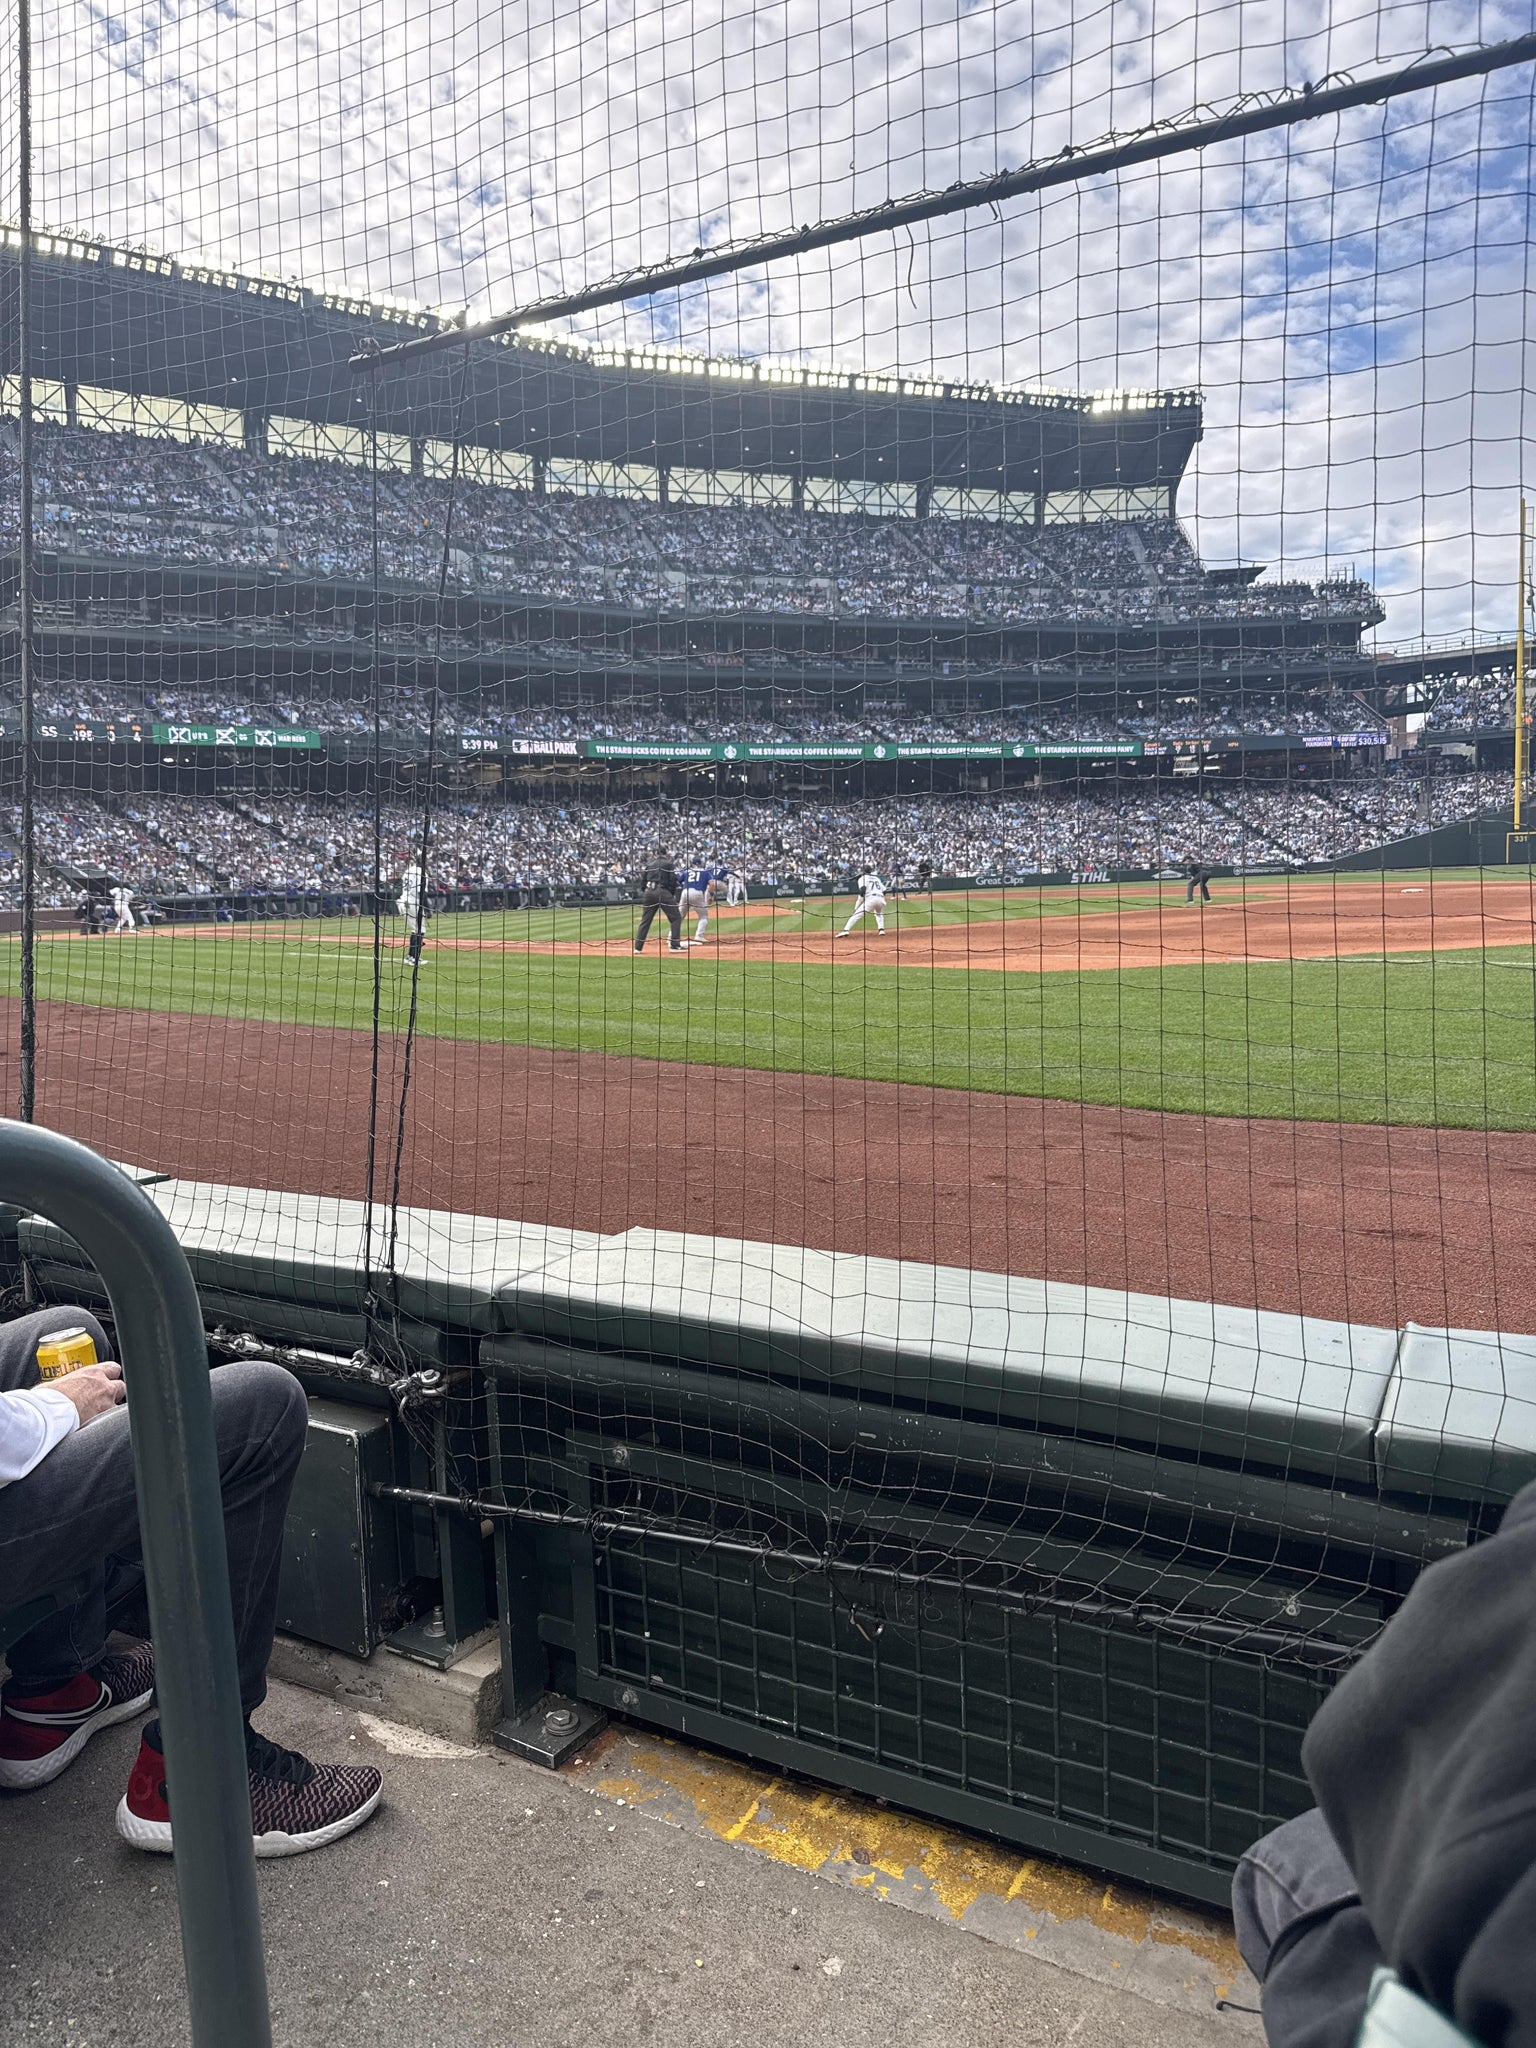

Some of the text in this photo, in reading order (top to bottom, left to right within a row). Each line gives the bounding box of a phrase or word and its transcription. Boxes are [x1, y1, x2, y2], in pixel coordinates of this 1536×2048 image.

[41, 726, 58, 737] SS
[133, 732, 141, 742] 4
[462, 739, 498, 750] 5:39 PM
[534, 741, 577, 754] BALLPARK
[595, 745, 711, 756] THE STARBUCKS COFFEE COMPANY
[897, 747, 910, 755] THE
[688, 870, 700, 882] 21
[976, 876, 1024, 886] Great Clips
[1070, 872, 1111, 883] STIHL
